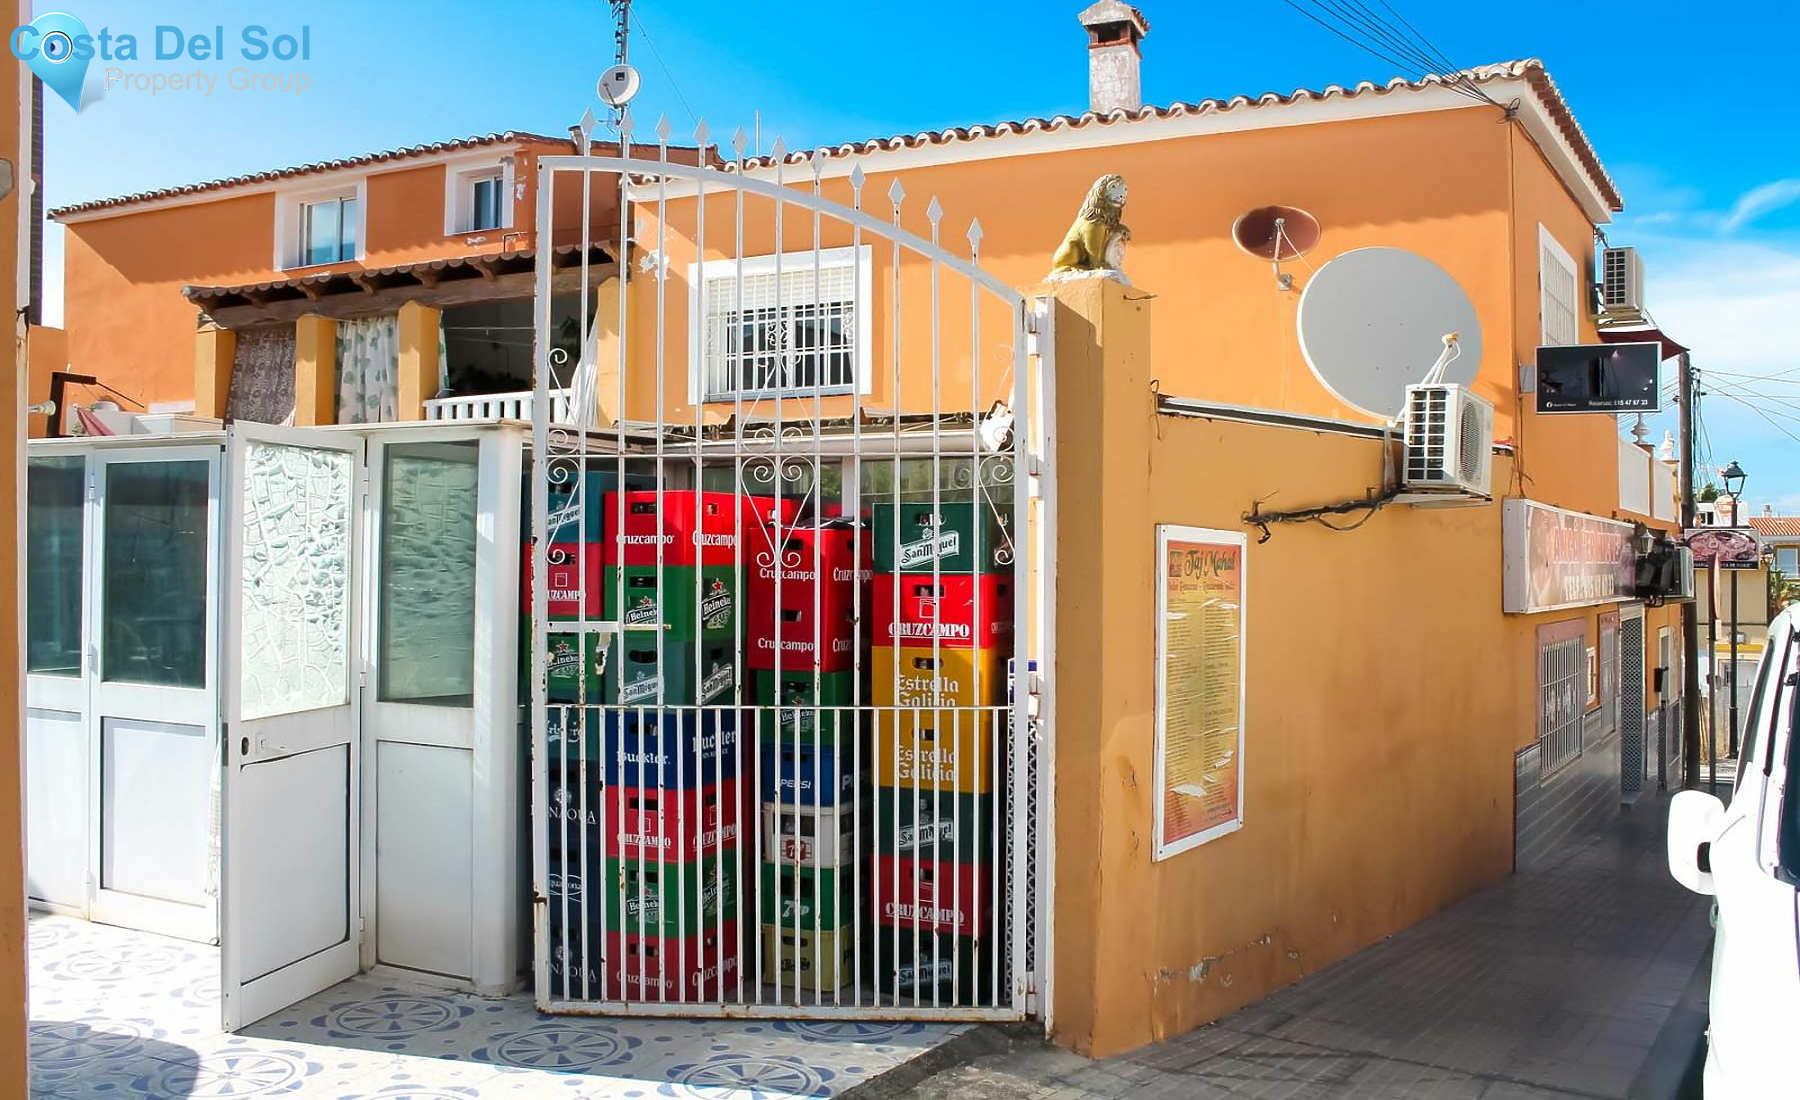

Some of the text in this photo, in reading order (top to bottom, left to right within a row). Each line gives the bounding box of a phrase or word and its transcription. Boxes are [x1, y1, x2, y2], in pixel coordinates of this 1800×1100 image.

[760, 567, 815, 582] Crucampo
[758, 638, 815, 652] Crucampo
[780, 779, 811, 789] PESI
